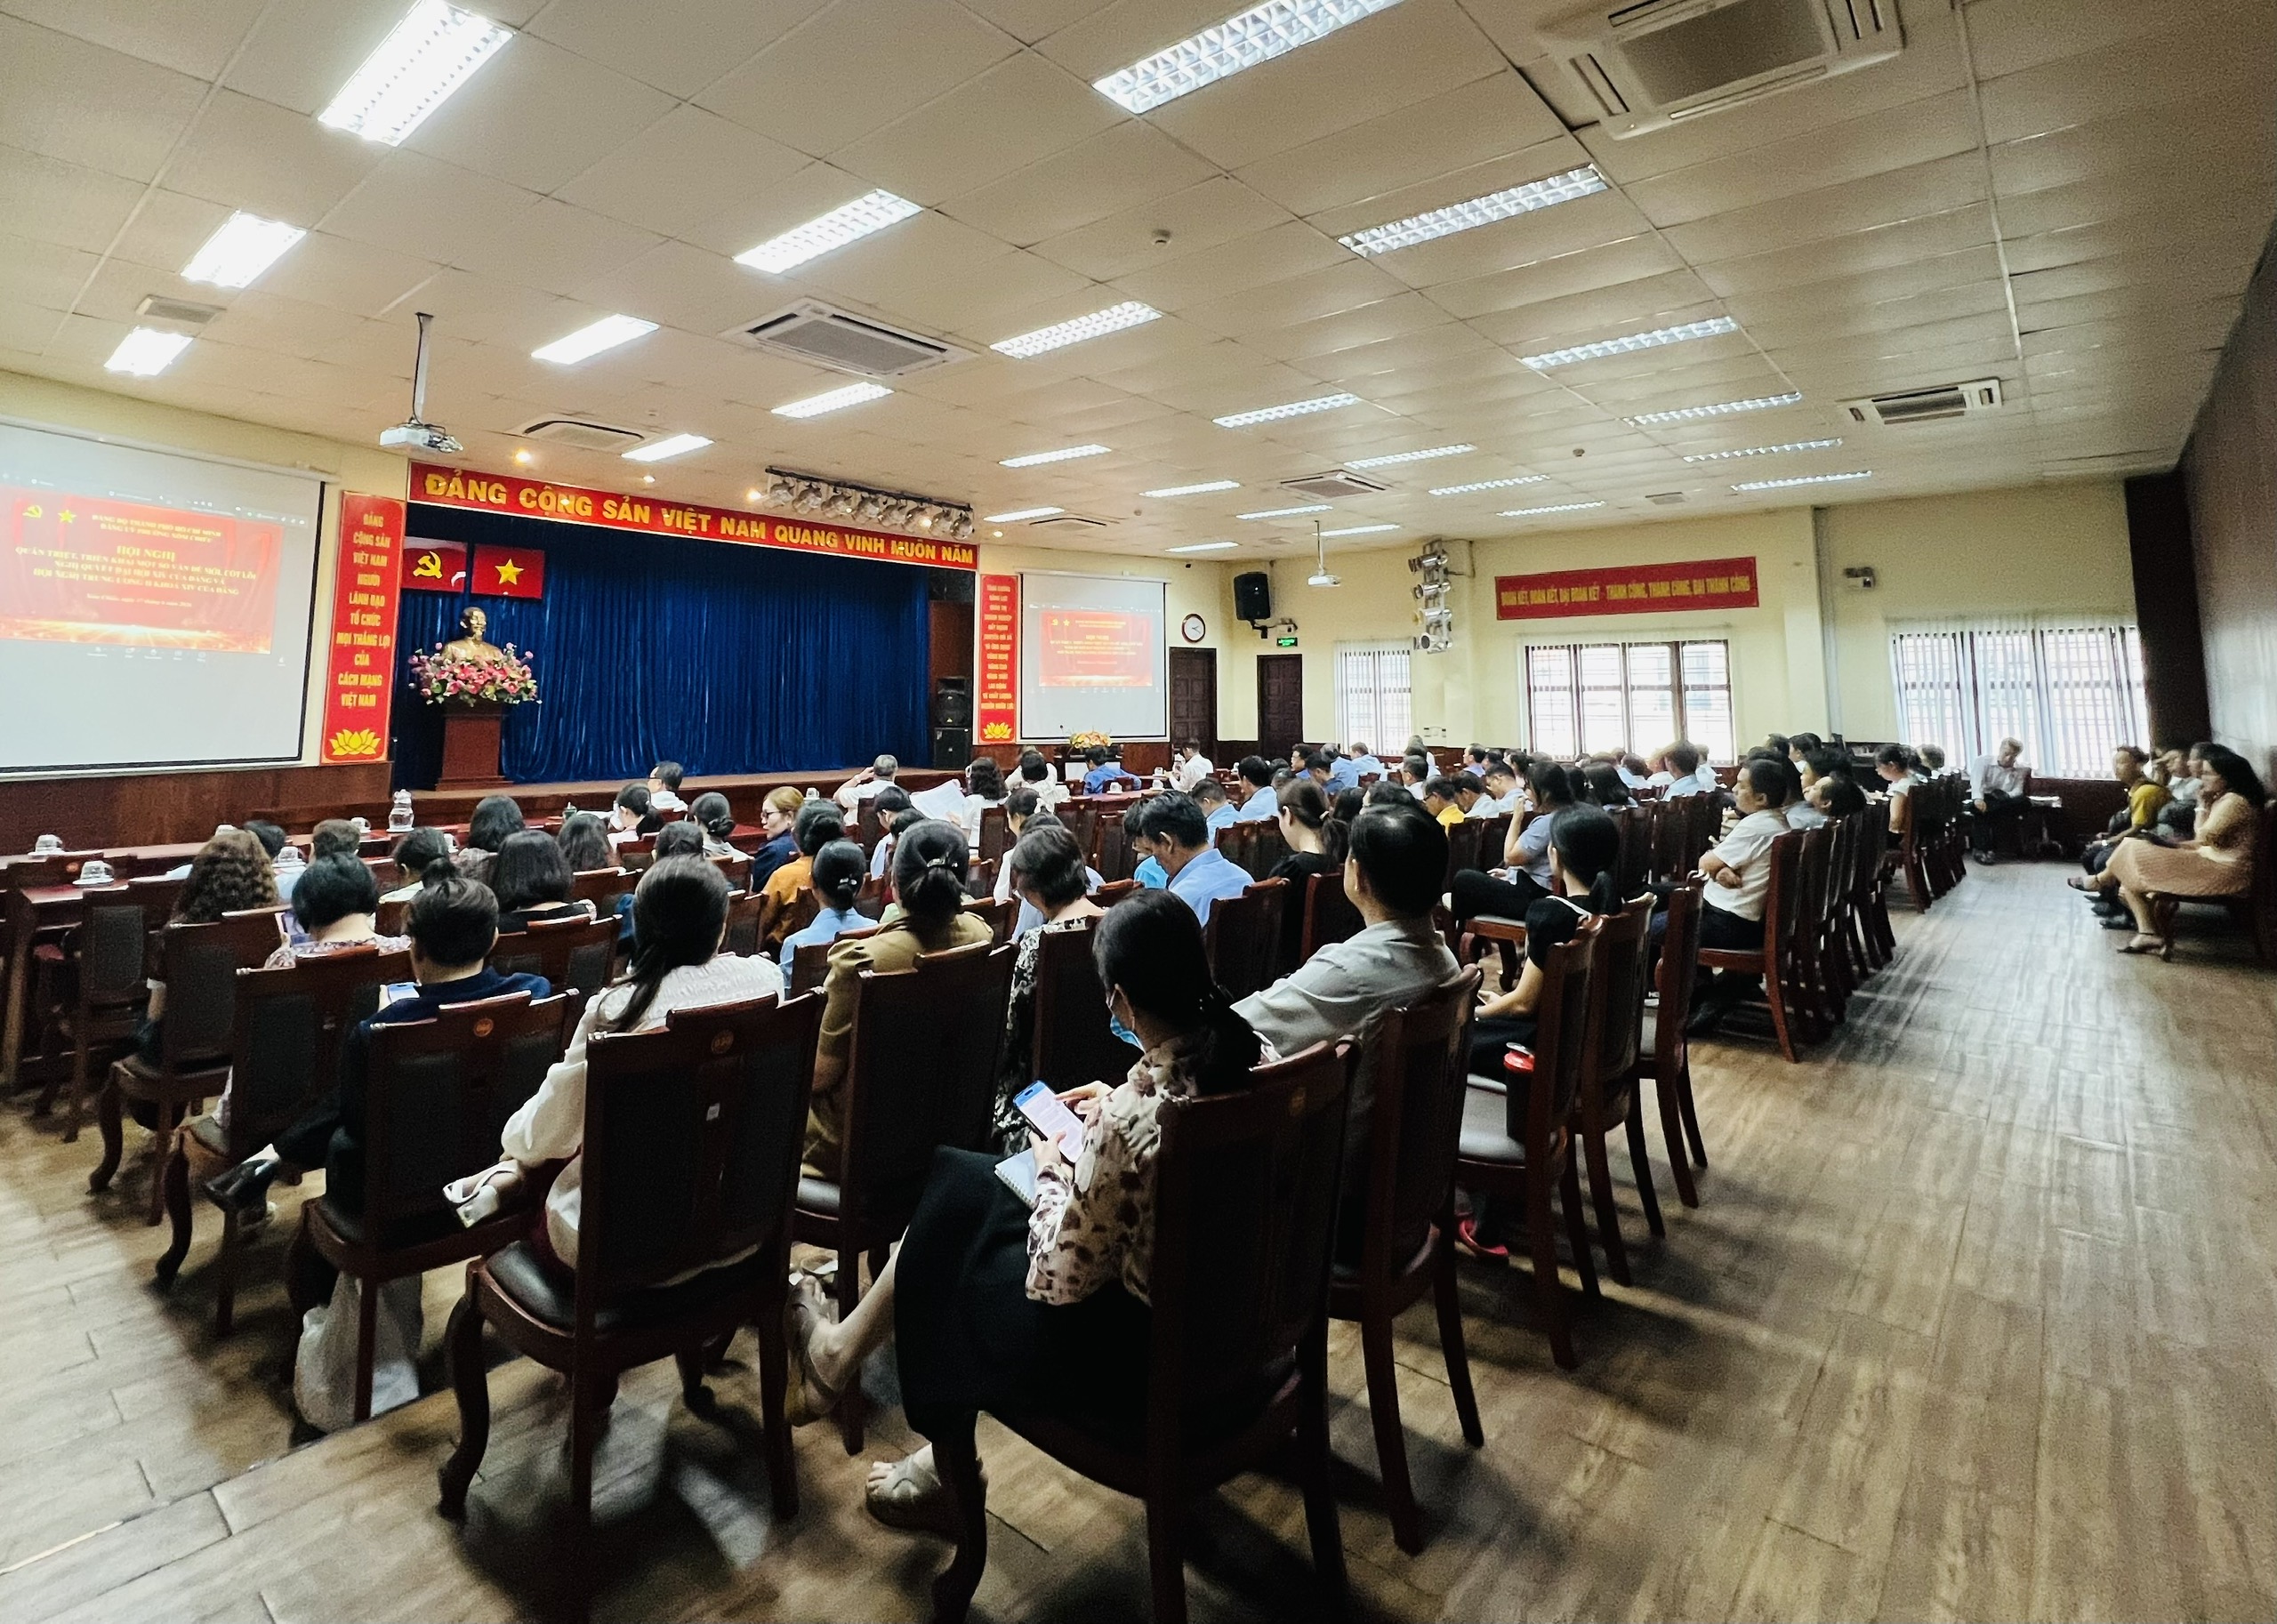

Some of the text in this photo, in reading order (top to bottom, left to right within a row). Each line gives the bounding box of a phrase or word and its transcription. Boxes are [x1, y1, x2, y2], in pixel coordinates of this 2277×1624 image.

[425, 469, 973, 564] ĐẢNG CỘNG SẢN VIỆT NAM QUANG VINH MUÔN NĂM
[374, 533, 391, 548] SẢN
[144, 548, 175, 562] NGHỊ
[353, 551, 388, 567] VIỆT NAM
[341, 692, 376, 709] VIỆT NAM
